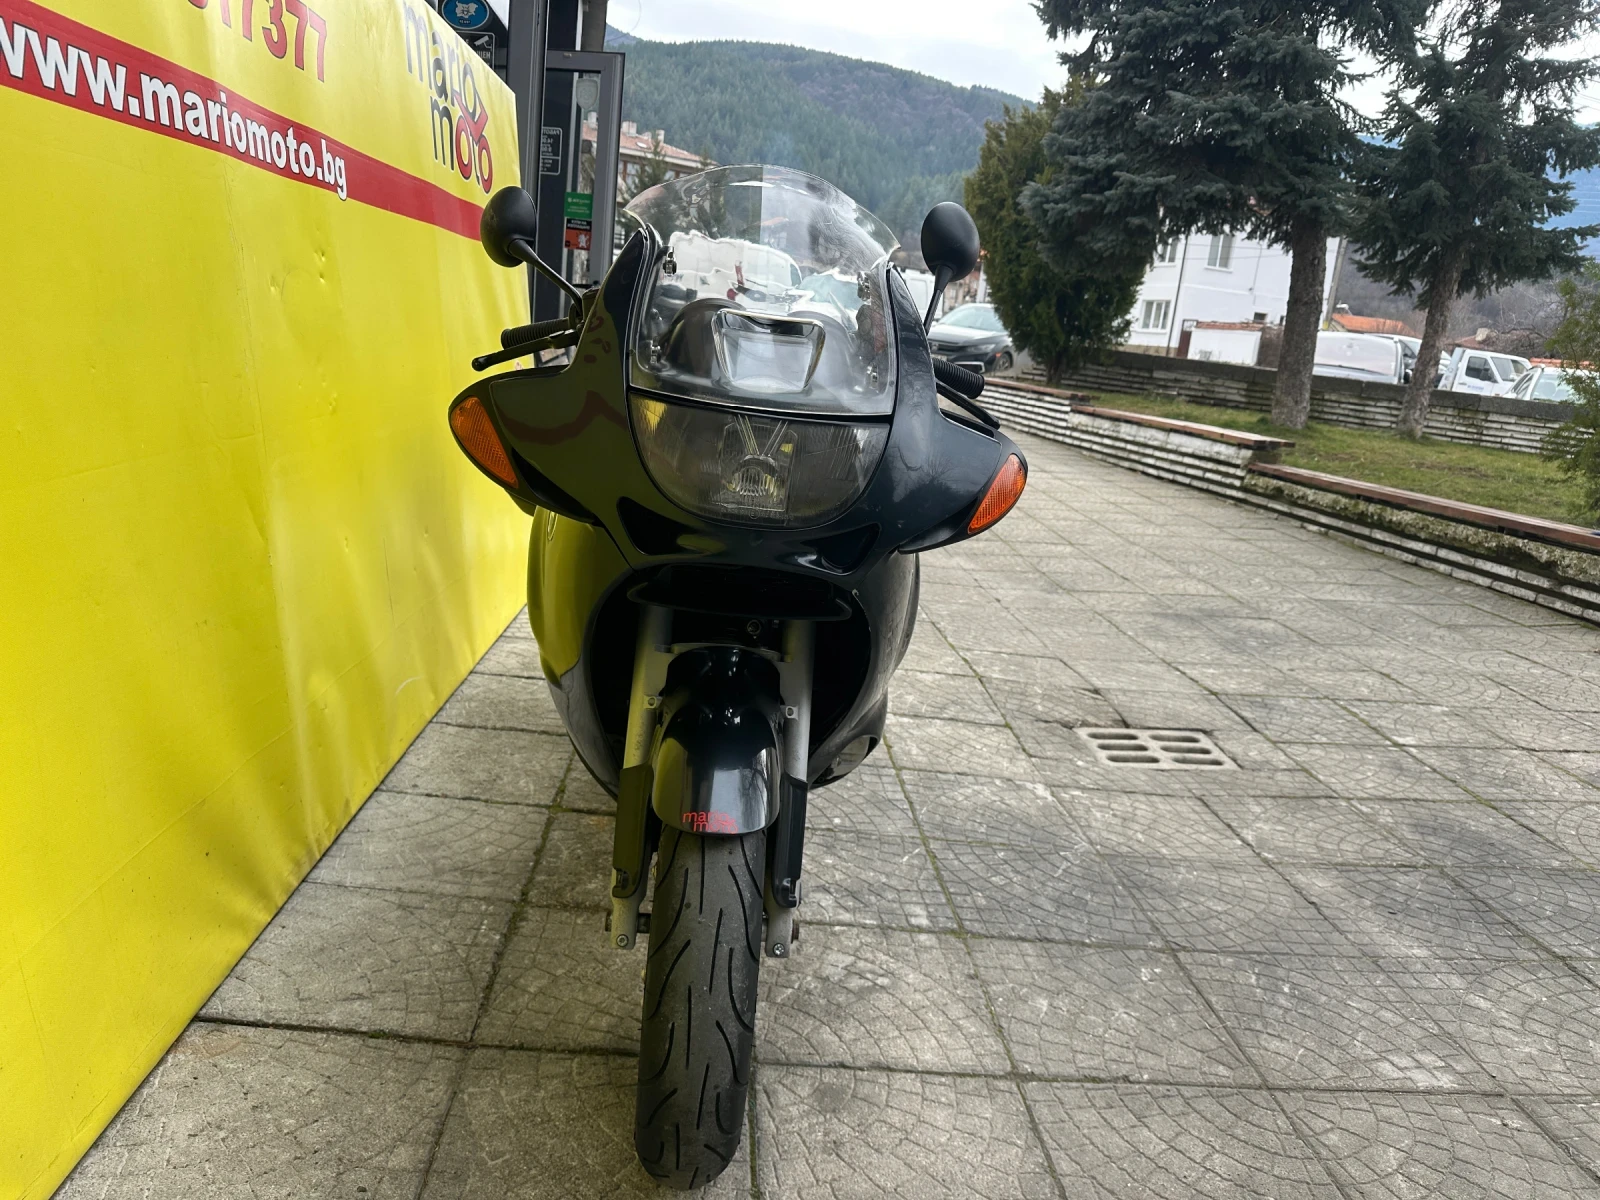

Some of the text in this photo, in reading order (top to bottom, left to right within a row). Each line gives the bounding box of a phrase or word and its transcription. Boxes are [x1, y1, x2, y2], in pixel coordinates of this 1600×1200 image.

[404, 2, 477, 120] mario
[430, 95, 493, 194] moto
[683, 811, 729, 822] mario
[694, 821, 738, 833] moto
